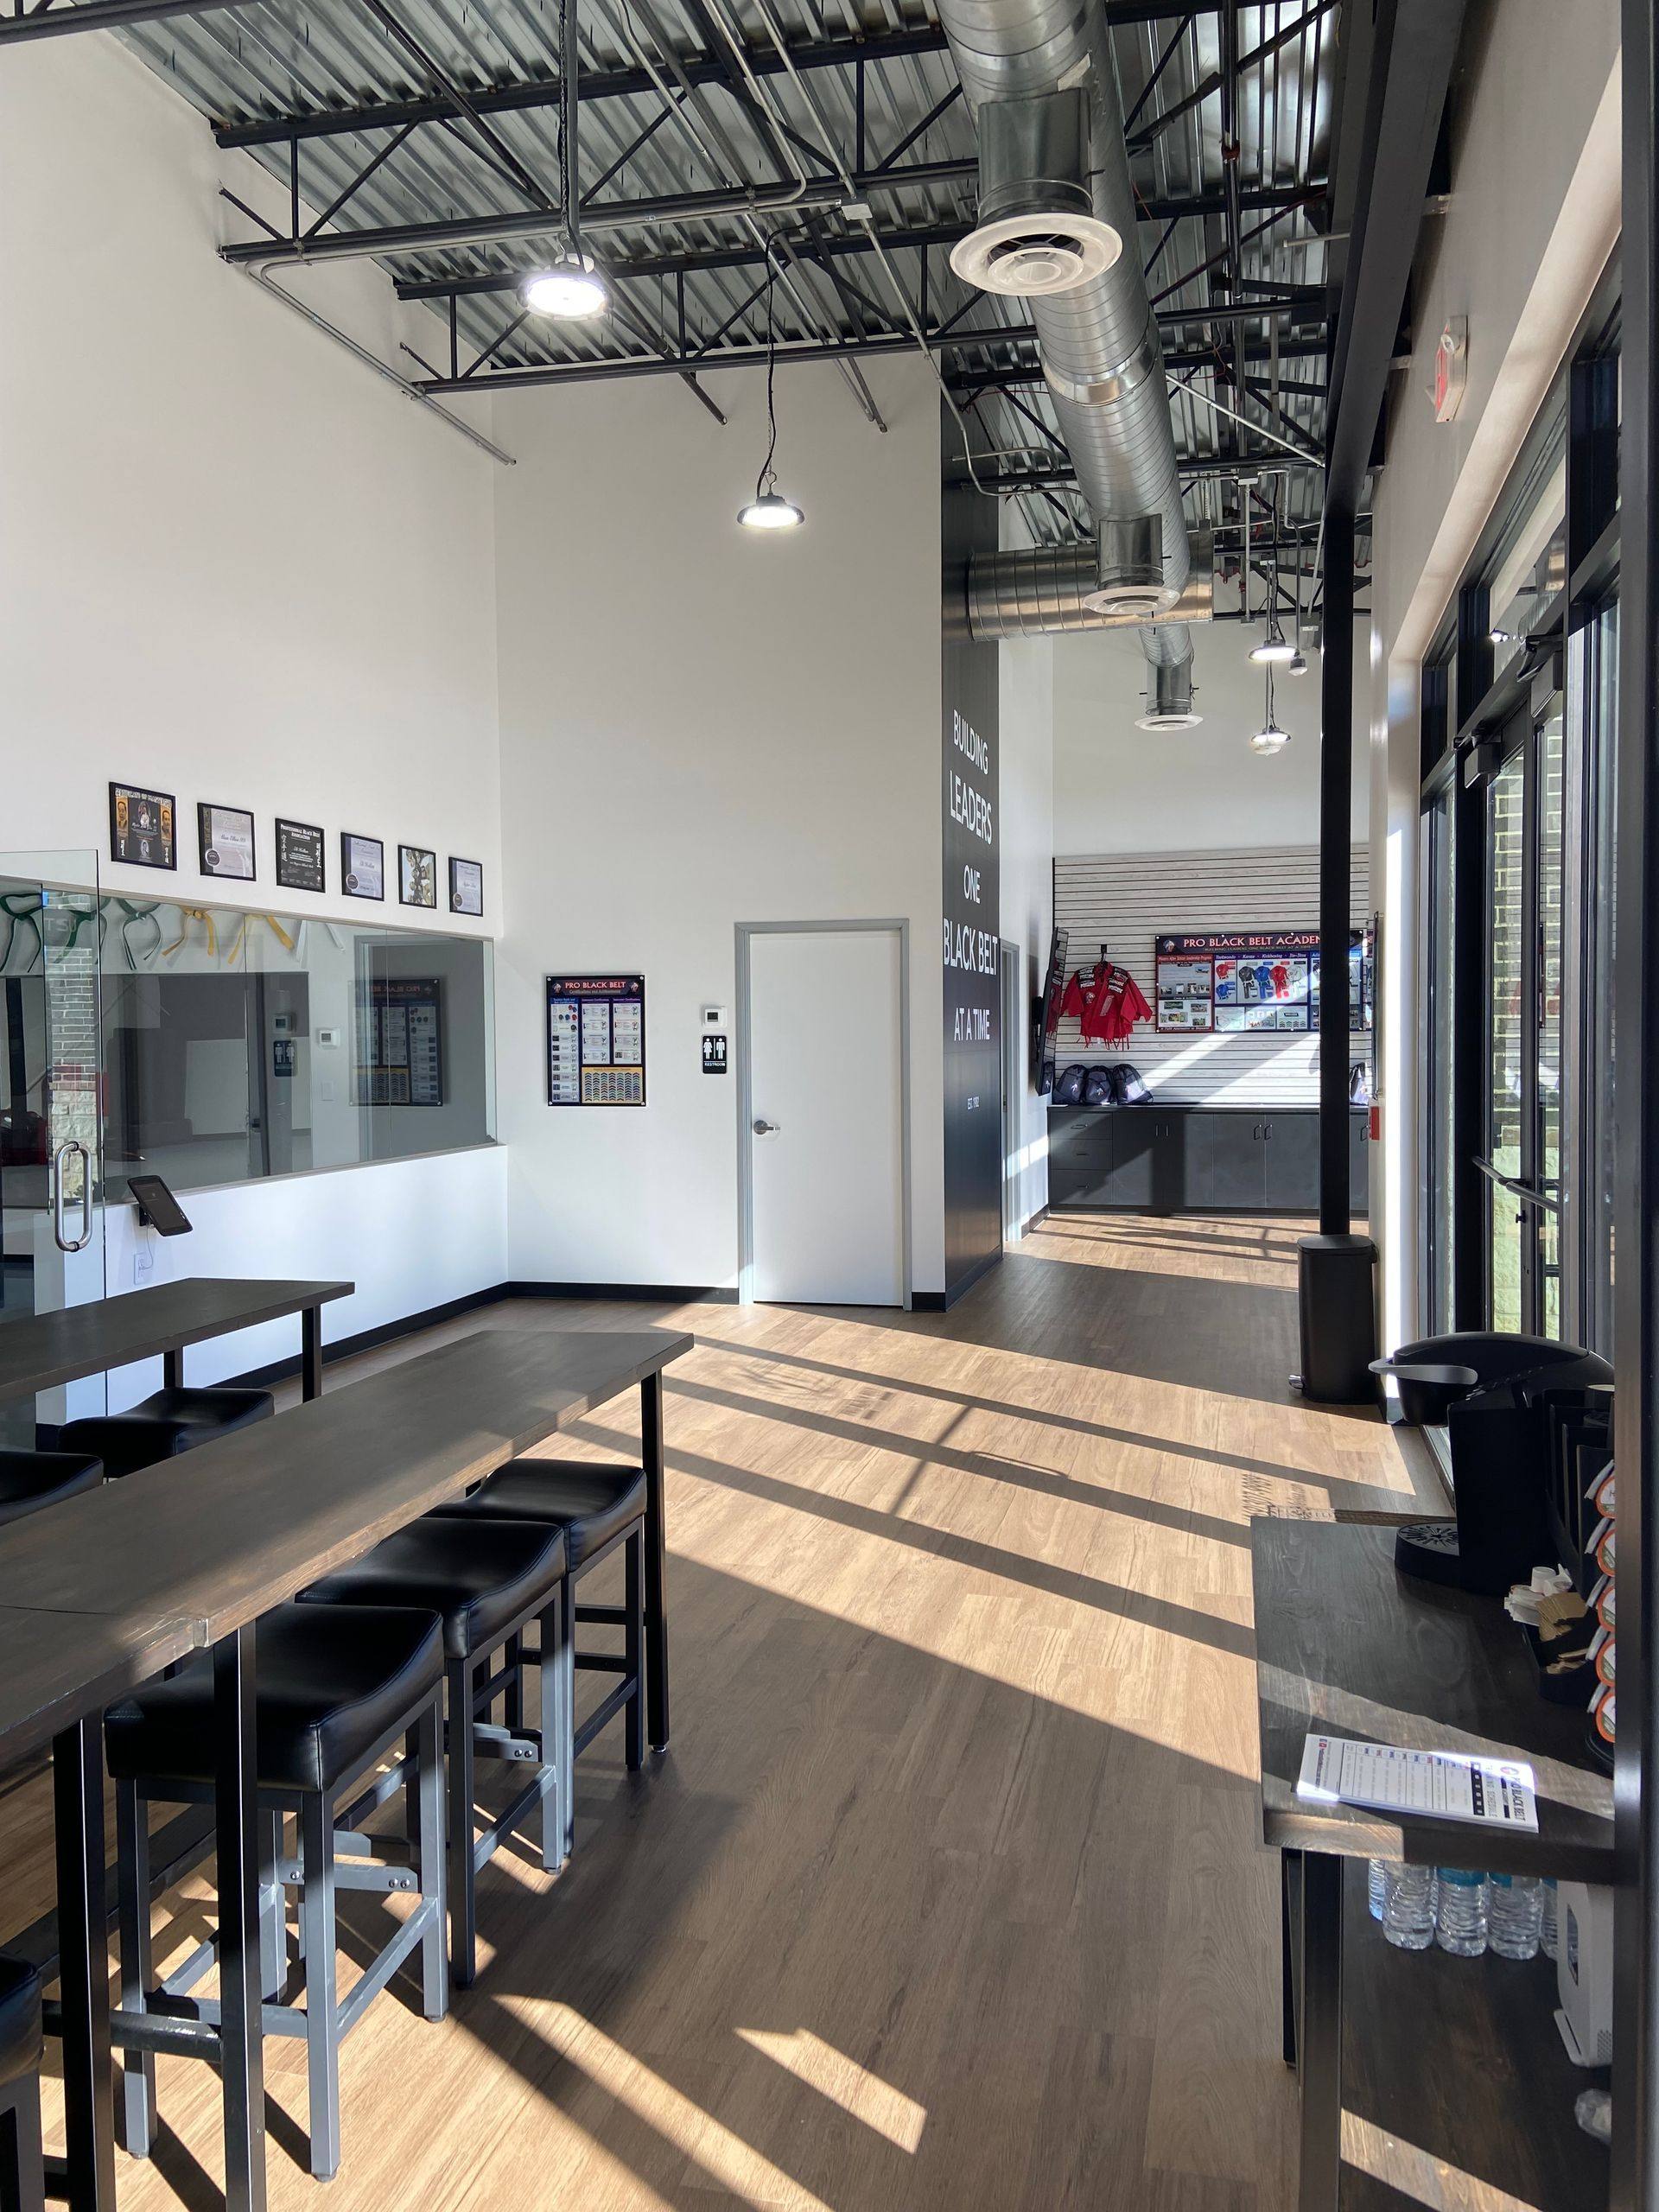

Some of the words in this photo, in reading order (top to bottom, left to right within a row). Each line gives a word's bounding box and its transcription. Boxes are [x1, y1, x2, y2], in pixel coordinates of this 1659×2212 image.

[953, 709, 988, 775] BUILDING
[950, 769, 993, 845] LEADERS
[963, 864, 981, 904] ONE
[944, 918, 976, 972] BLACK
[978, 930, 998, 976] BELT
[1184, 938, 1205, 948] PRO
[1209, 938, 1245, 947] BLACK
[1249, 937, 1273, 946] BELT
[1275, 935, 1320, 945] ACADE
[954, 1007, 965, 1041] AT
[966, 1008, 973, 1040] A
[973, 1008, 990, 1040] TIME
[1512, 1789, 1523, 1808] BLACK
[1514, 1808, 1526, 1821] BELT
